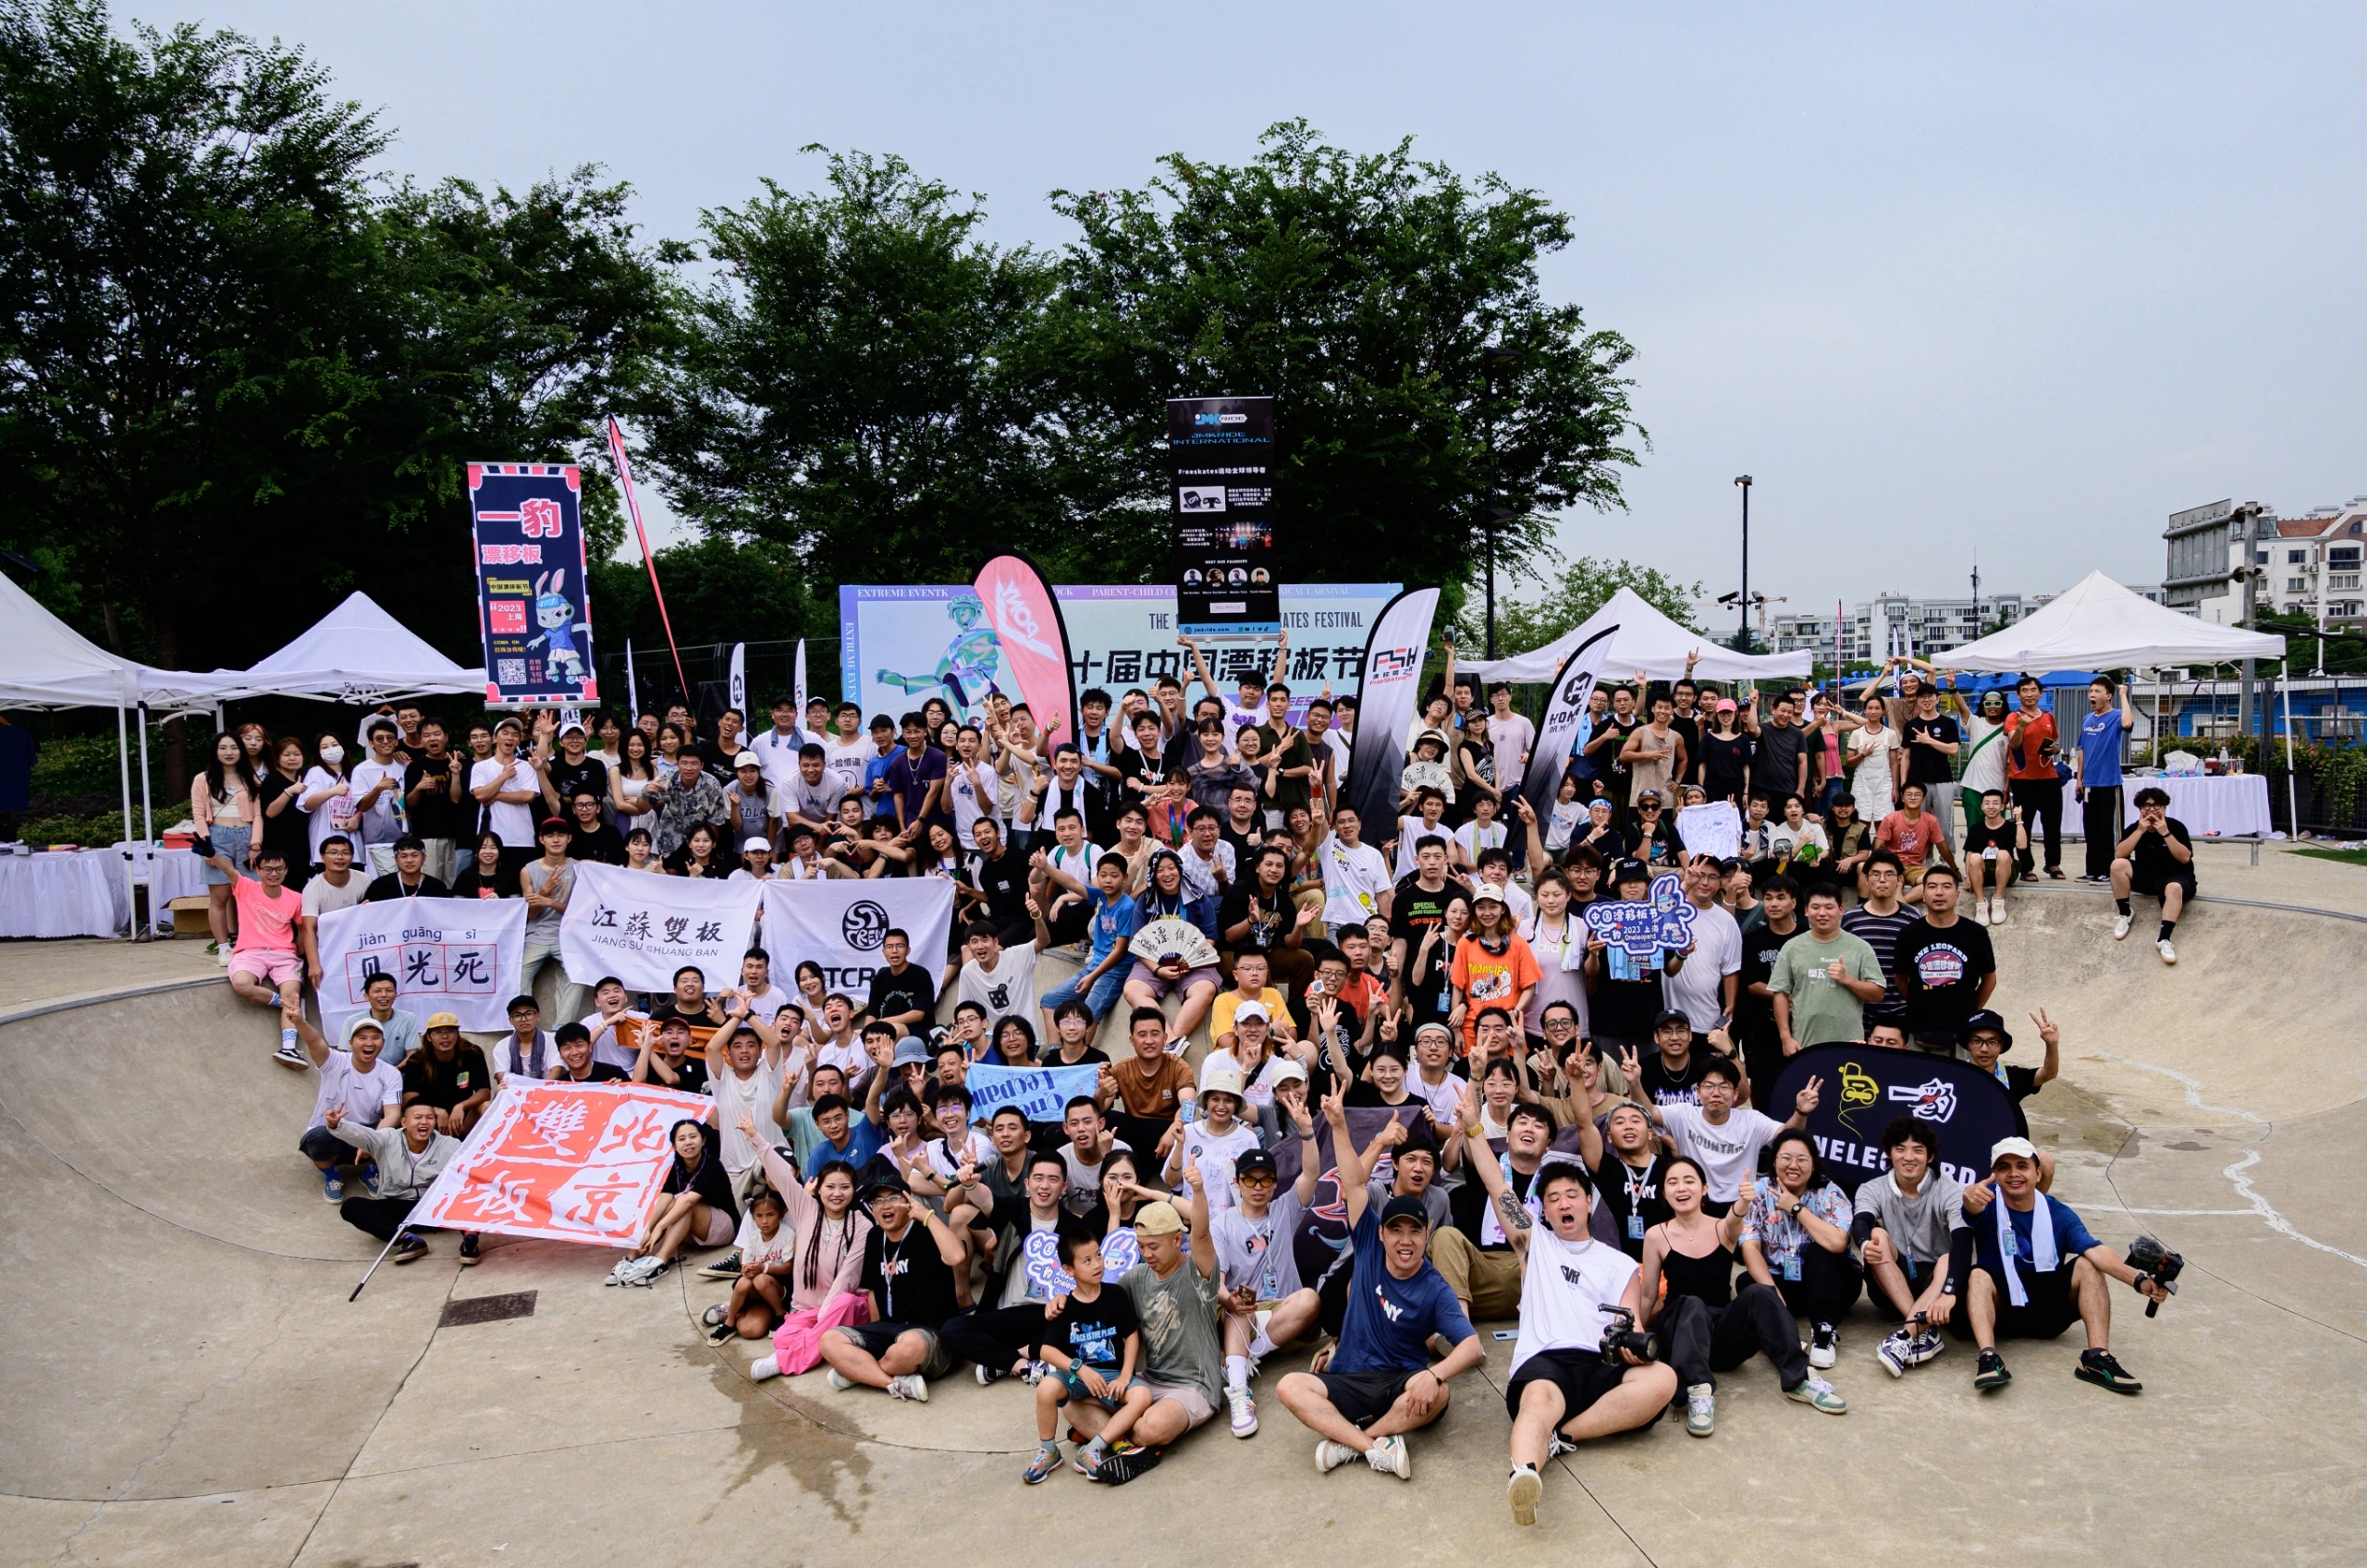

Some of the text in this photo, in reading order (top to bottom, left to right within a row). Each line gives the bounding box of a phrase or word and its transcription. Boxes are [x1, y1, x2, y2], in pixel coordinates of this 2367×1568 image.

[477, 498, 563, 538] 一豹
[481, 544, 543, 565] 漂移板
[490, 582, 529, 592] 中国漂移板节
[857, 587, 949, 597] EXTREME EVENTK
[1092, 588, 1163, 597] PARENT-CHILD
[1306, 586, 1351, 594] CARNIVAL
[497, 604, 521, 612] 2023
[506, 613, 523, 621] 上海
[1149, 613, 1170, 630] THE
[1315, 611, 1364, 628] FESTIVAL
[845, 622, 855, 667] EXTREME
[1414, 901, 1437, 910] SPECIAL
[1589, 908, 1660, 924] 中国漂移板节
[592, 904, 724, 945] 江蘇雙板
[1623, 925, 1643, 935] 2023
[1644, 925, 1661, 935] 上海
[358, 926, 477, 950] jiàn guāng sǐ
[1600, 928, 1623, 942] 一豹
[1624, 933, 1658, 942] Oneleopard
[591, 934, 718, 958] JIANG SU SHUANG BAN
[1914, 943, 1968, 963] ONE LEOPARD
[1070, 1331, 1086, 1343] SPACE
[1091, 1329, 1101, 1339] THE
[1101, 1326, 1117, 1338] PLACE
